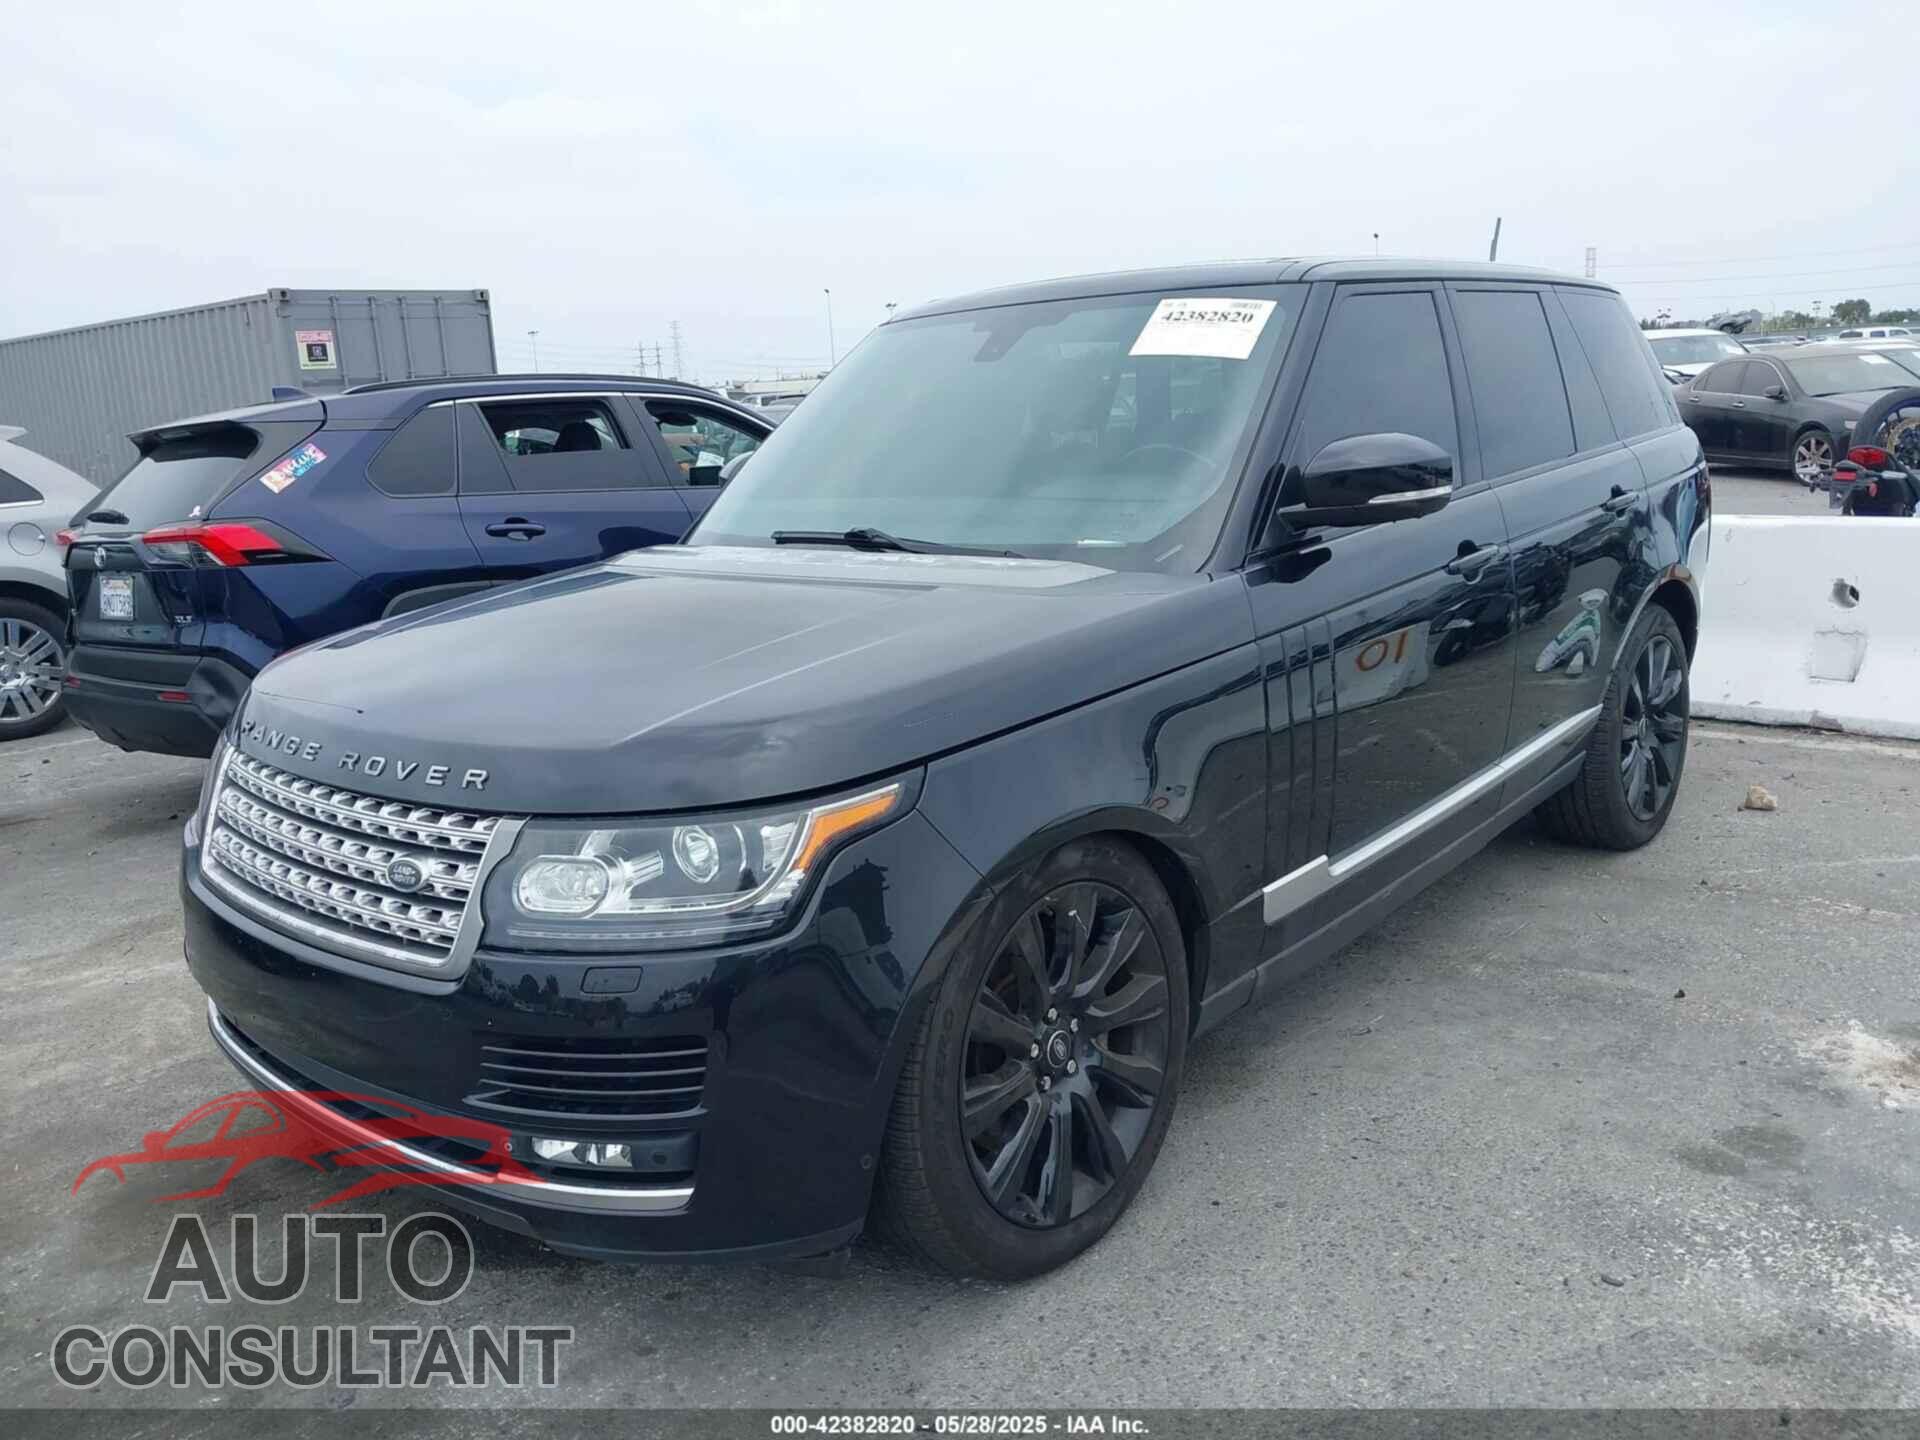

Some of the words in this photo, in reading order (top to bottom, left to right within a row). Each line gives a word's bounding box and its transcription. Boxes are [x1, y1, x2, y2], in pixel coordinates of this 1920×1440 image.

[1162, 311, 1254, 323] 42382820
[241, 720, 321, 762] RANGE
[338, 752, 490, 790] ROVER
